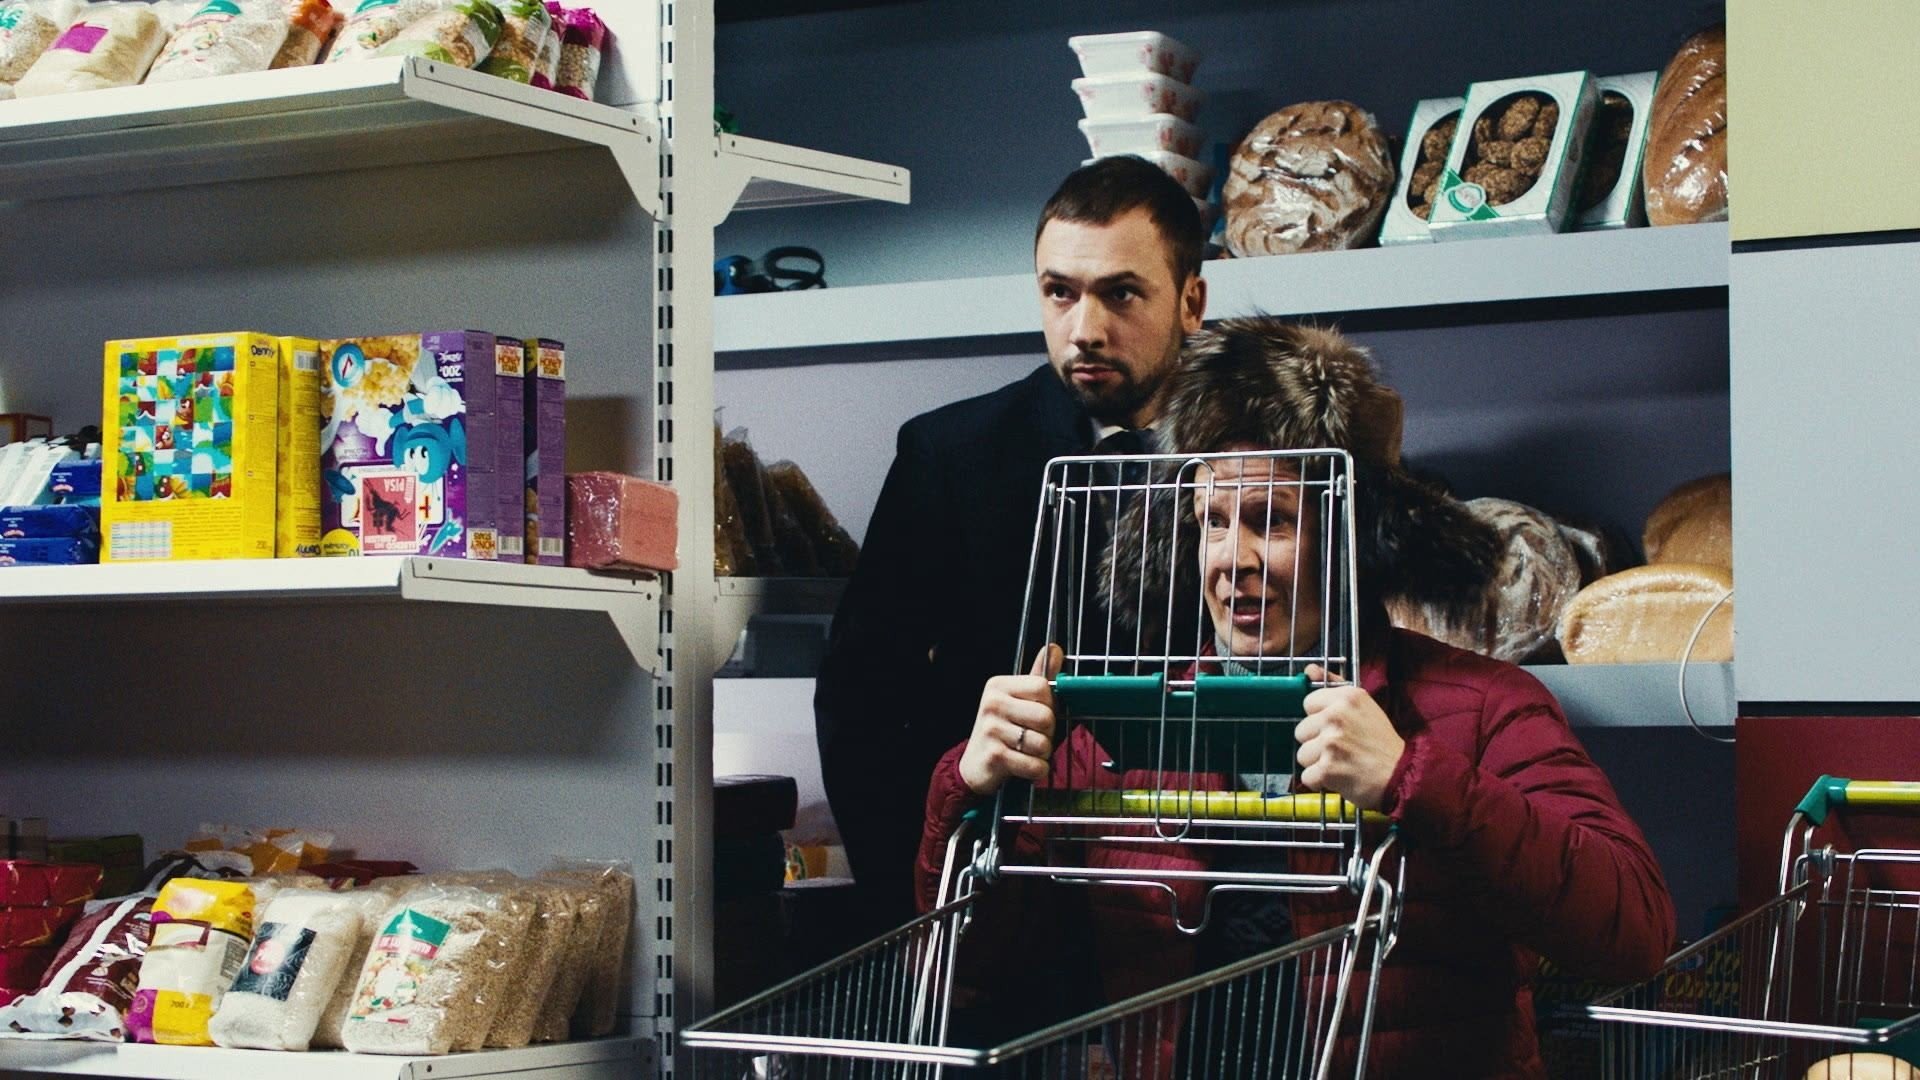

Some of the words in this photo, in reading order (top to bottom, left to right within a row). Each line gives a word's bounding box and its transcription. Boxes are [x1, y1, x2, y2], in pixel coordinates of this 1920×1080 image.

[499, 355, 520, 364] HONEY
[540, 358, 561, 368] HONEY
[384, 479, 404, 492] PISA
[470, 540, 496, 550] HONEY
